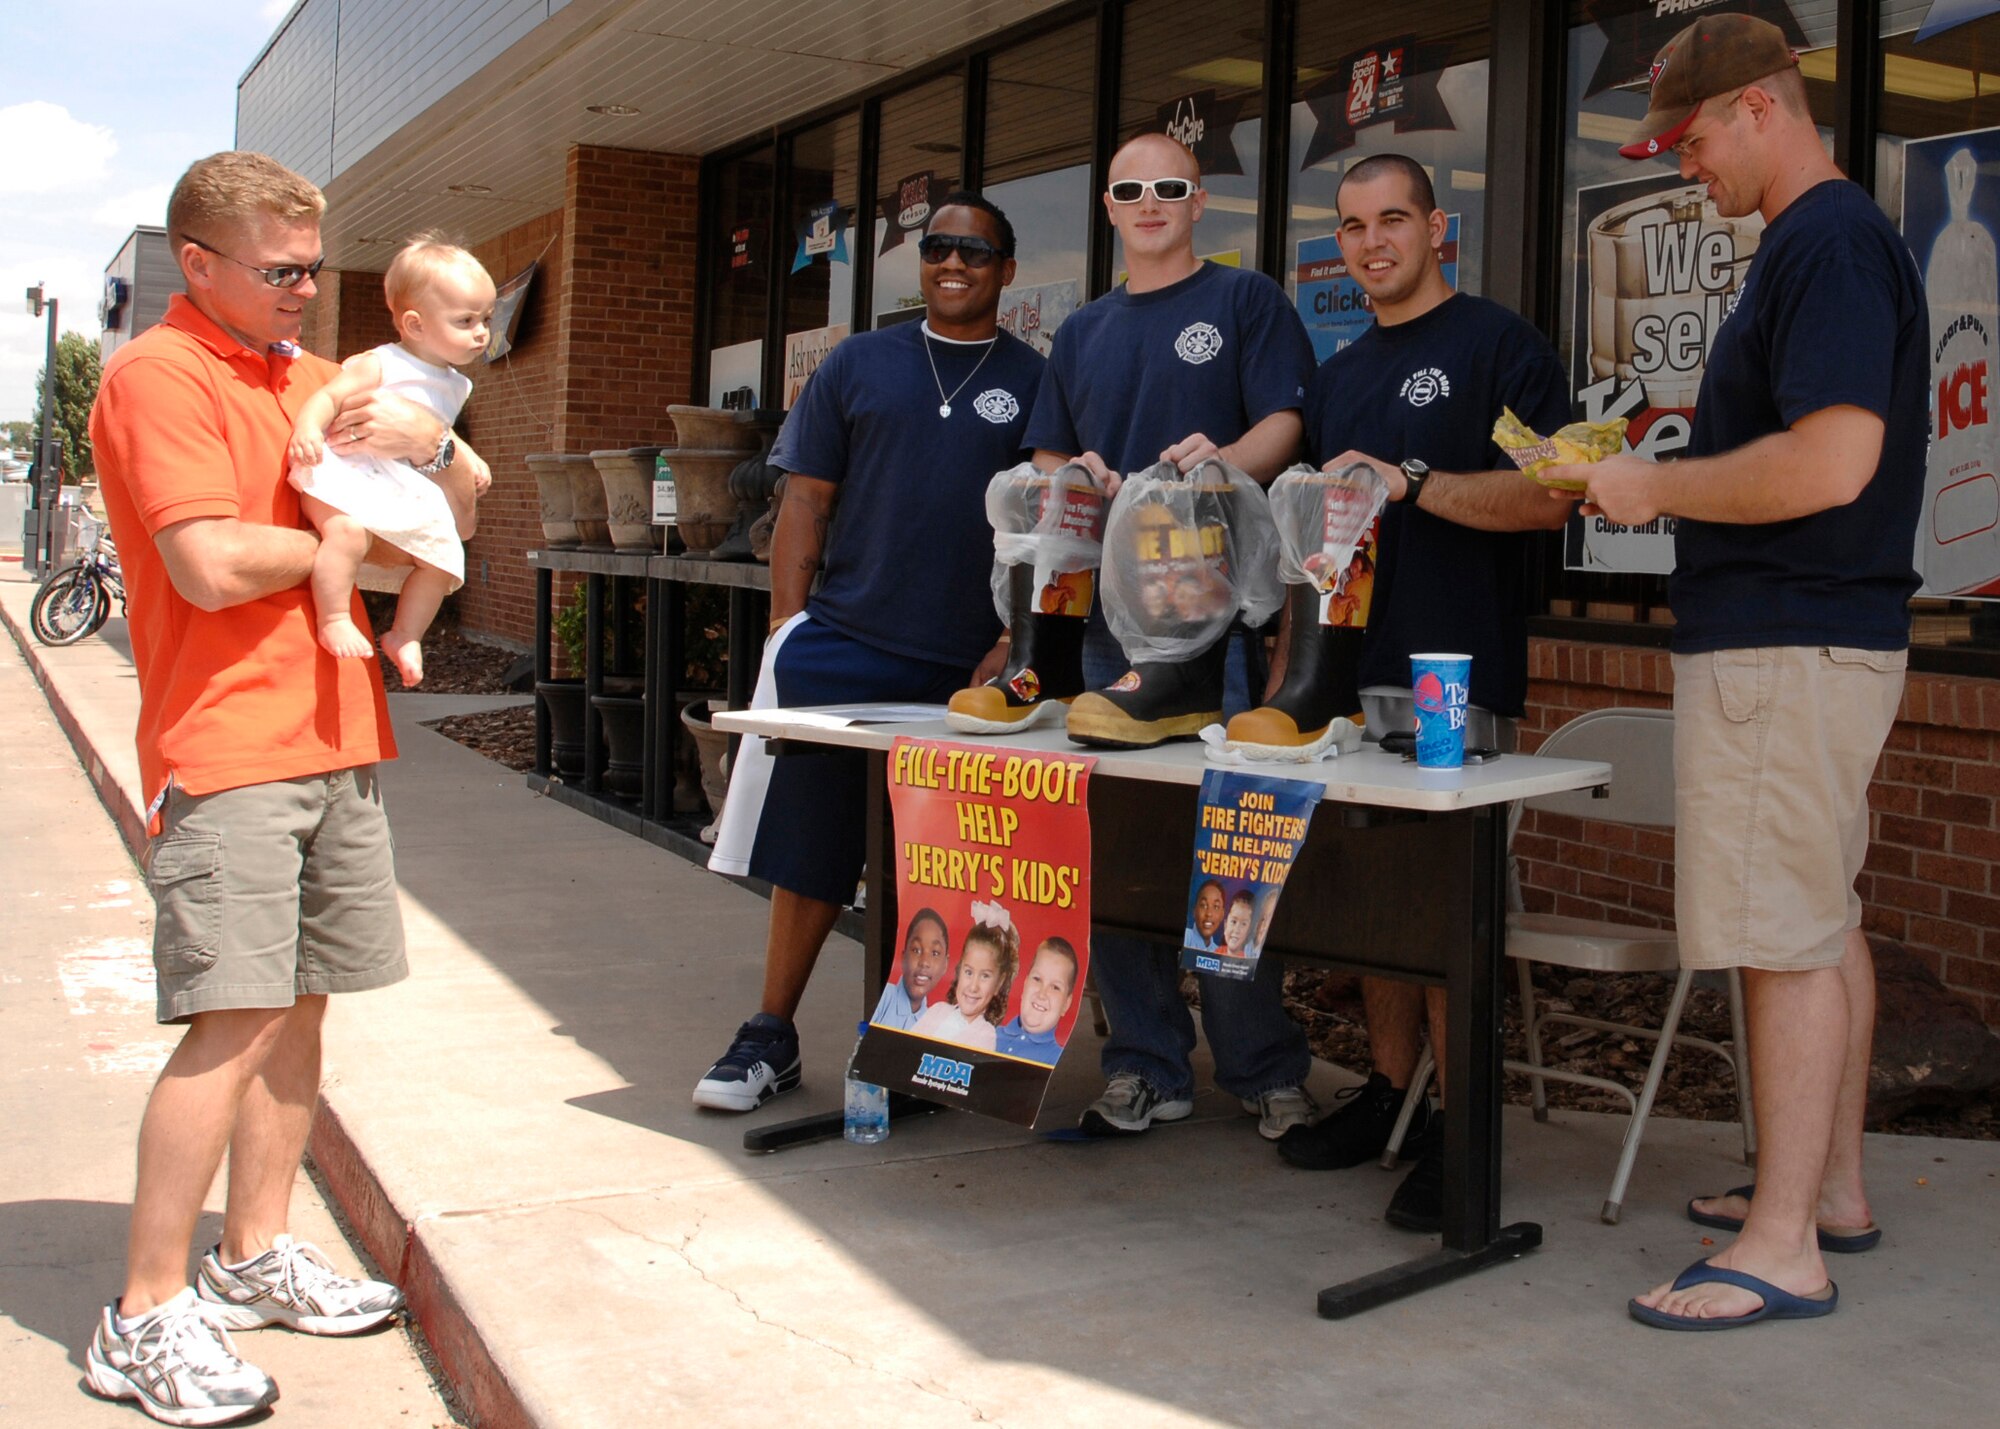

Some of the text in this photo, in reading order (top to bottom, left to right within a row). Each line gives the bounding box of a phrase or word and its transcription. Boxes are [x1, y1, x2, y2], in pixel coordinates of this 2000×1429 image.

[1352, 64, 1376, 81] open
[1350, 75, 1374, 112] 24
[1642, 220, 1734, 295] We
[788, 340, 806, 379] Ask
[807, 348, 816, 376] us
[1438, 374, 1450, 398] BOOT
[1938, 359, 1988, 440] ICE
[1663, 517, 1676, 536] ic
[894, 744, 1085, 805] FILL-THE-BOOT
[1239, 791, 1275, 812] JOIN
[956, 801, 1019, 847] HELP
[1202, 806, 1306, 841] FIRE FIGHTERS
[1211, 833, 1293, 860] IN HELPING
[904, 842, 1005, 898] 'JERRY'S
[1196, 955, 1220, 972] MDA
[917, 1053, 974, 1087] MDA
